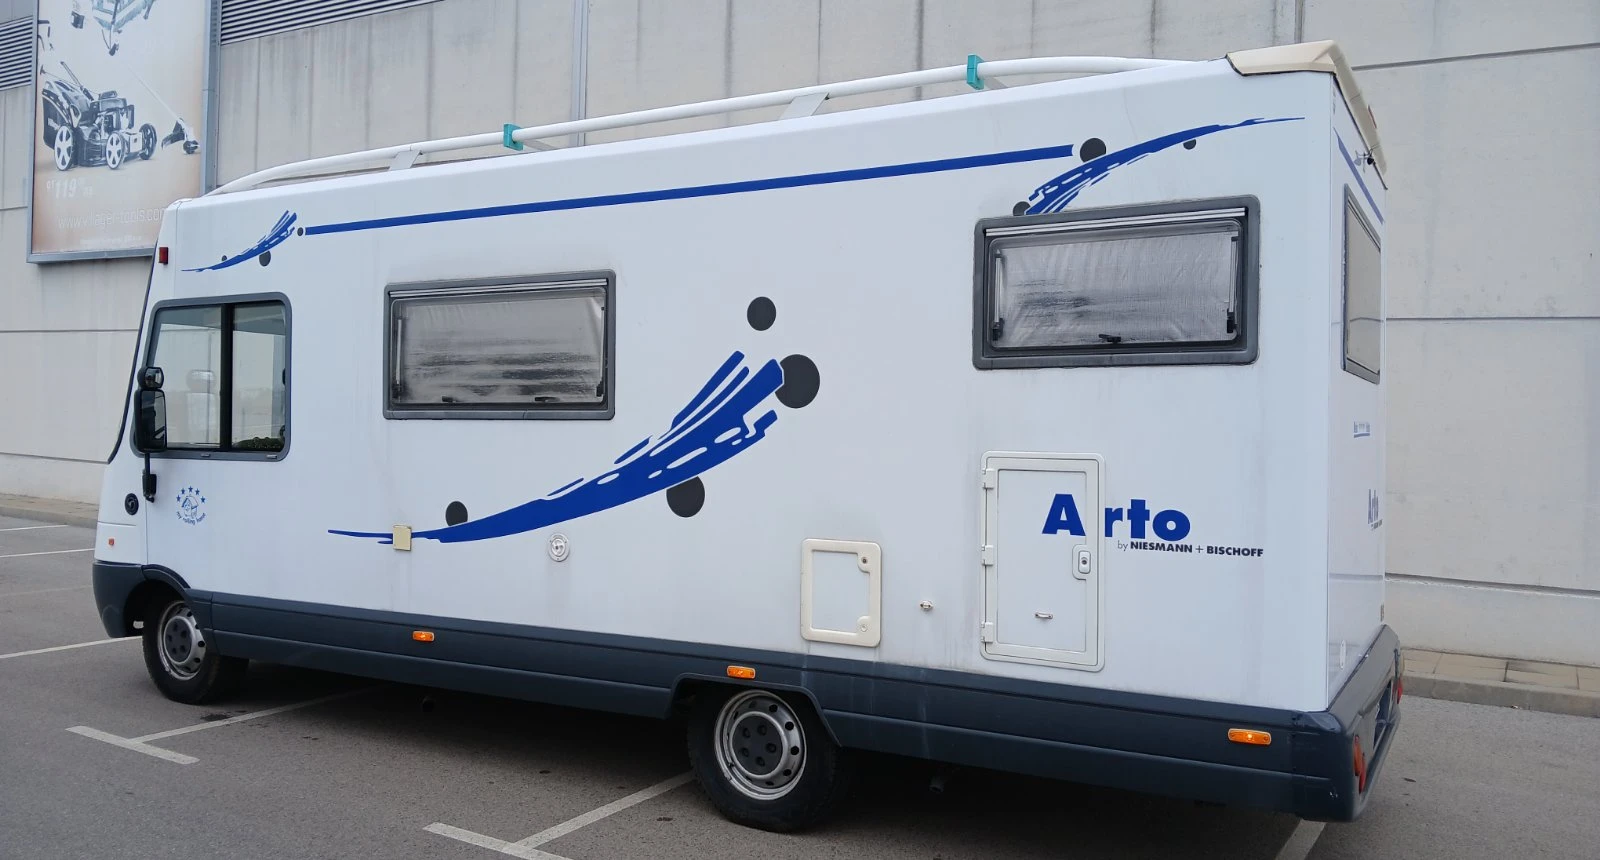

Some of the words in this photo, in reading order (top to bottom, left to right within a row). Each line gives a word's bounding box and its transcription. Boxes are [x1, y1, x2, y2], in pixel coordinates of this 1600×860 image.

[1042, 493, 1191, 542] Arto
[1117, 540, 1129, 552] by
[1130, 541, 1193, 554] NIESMANN
[1195, 545, 1204, 554] +
[1206, 545, 1264, 558] BISCHOFF
